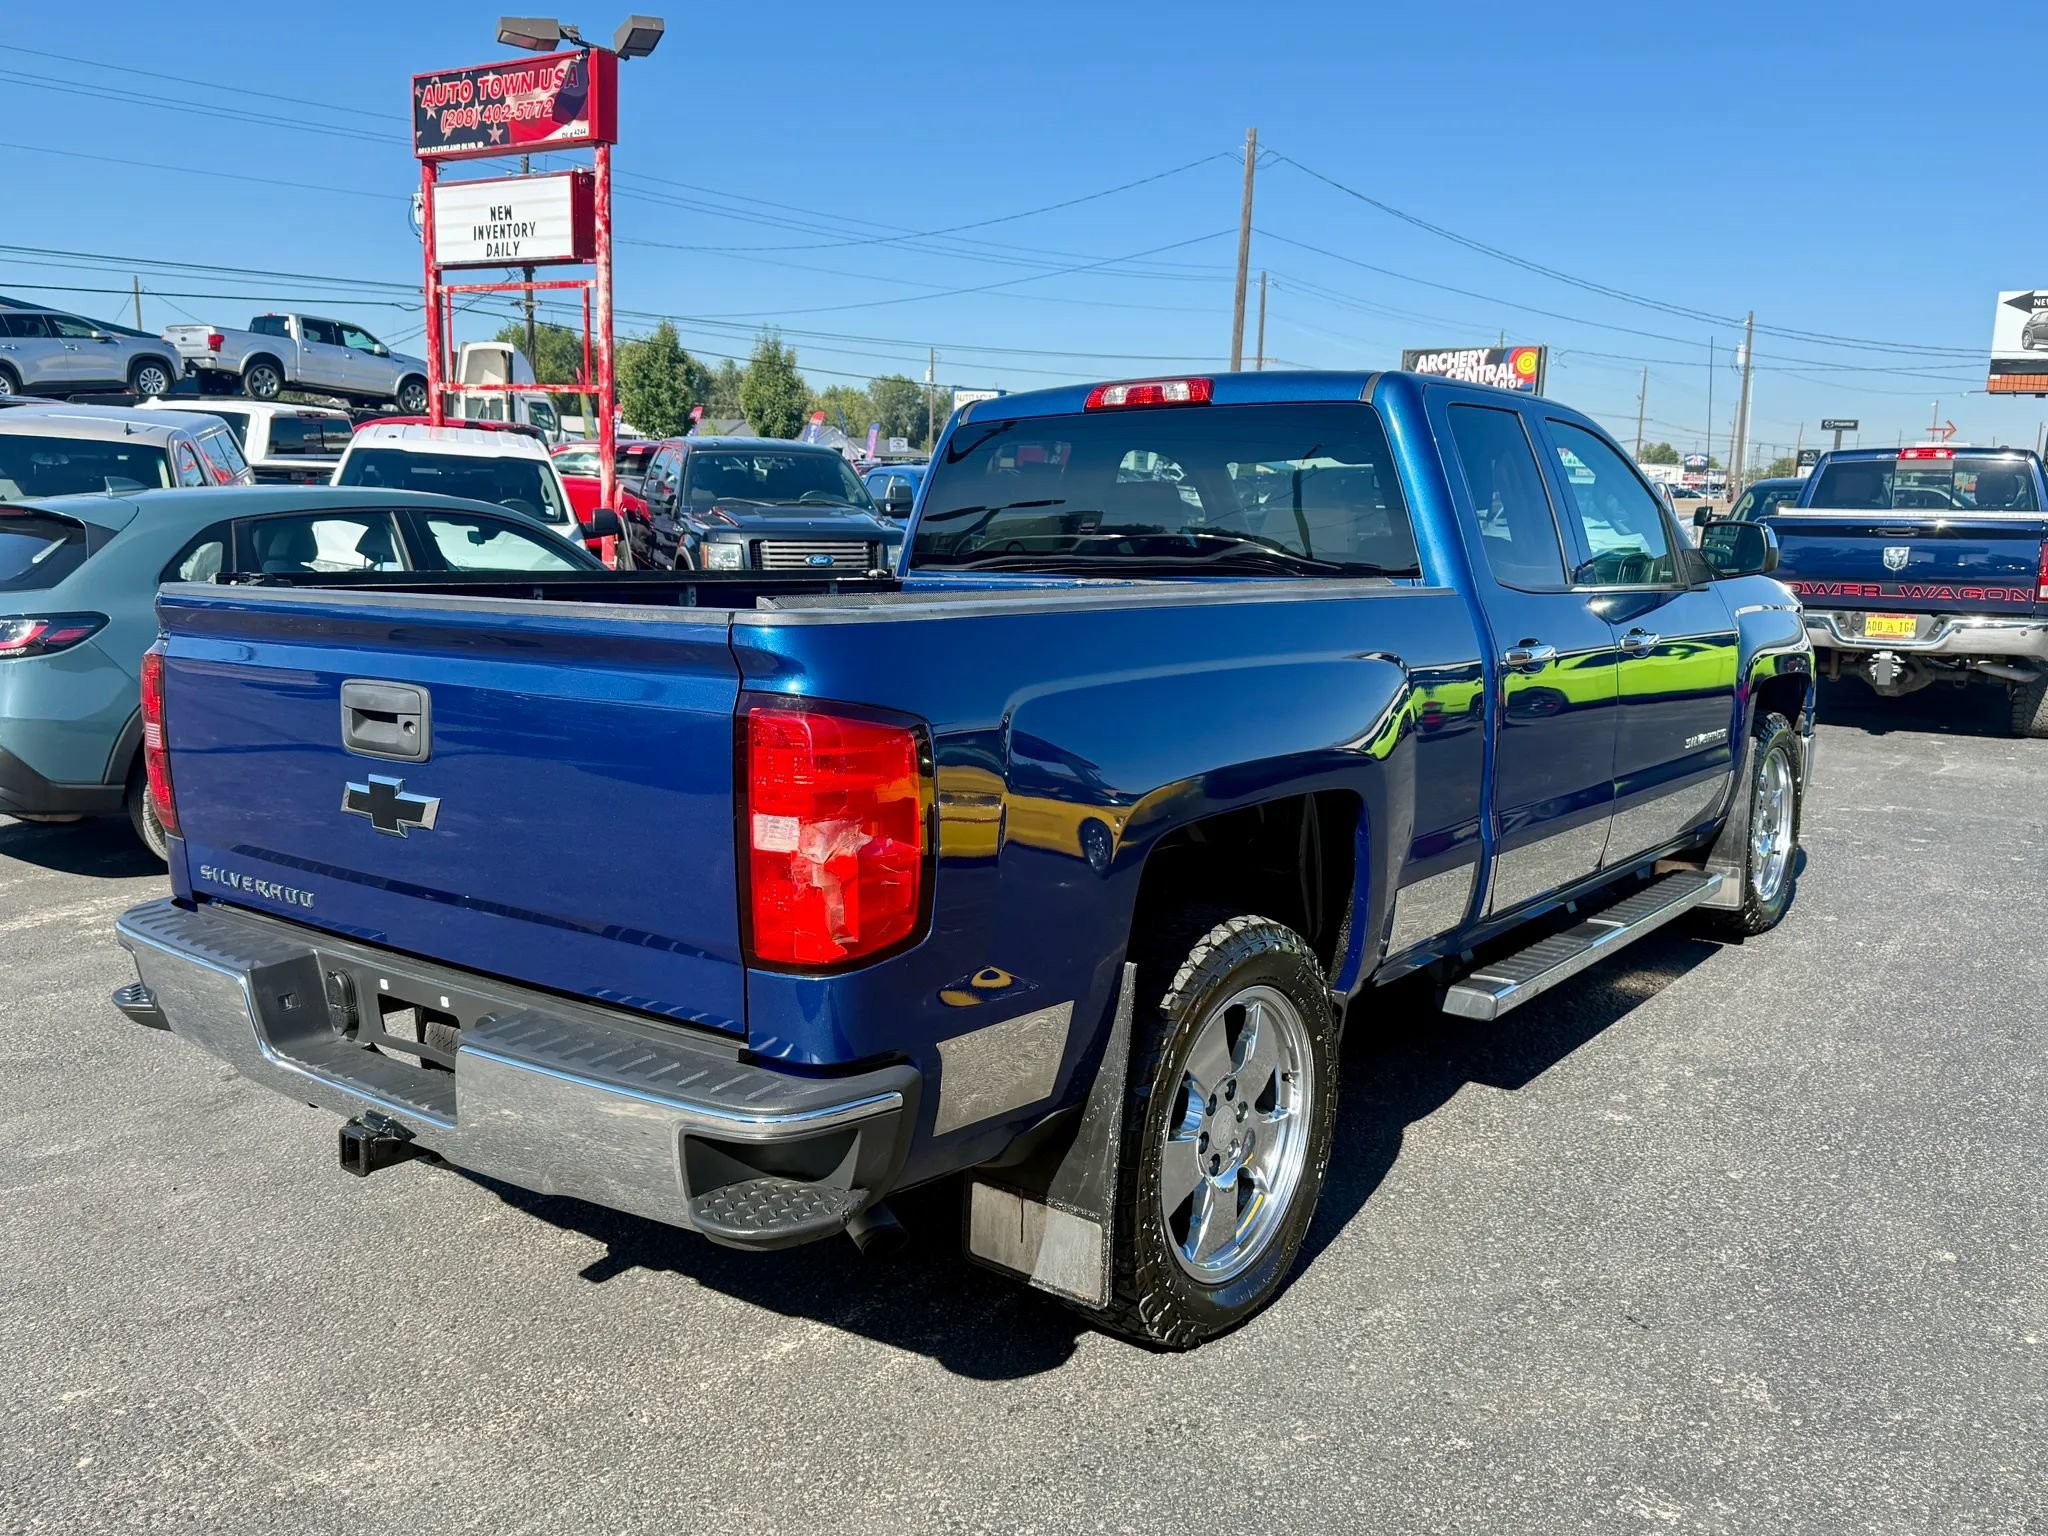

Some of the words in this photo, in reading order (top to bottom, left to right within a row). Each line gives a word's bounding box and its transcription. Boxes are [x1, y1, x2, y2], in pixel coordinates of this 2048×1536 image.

[421, 79, 473, 109] AUTO
[478, 71, 535, 100] TOWN
[539, 65, 578, 97] USA
[441, 107, 479, 133] (208)
[482, 97, 555, 124] 402-5772
[490, 205, 512, 222] NEW
[473, 221, 536, 241] INVENTORY
[486, 241, 520, 257] DAILY
[1415, 349, 1490, 374] ARCHERY
[1445, 363, 1517, 384] CENTRAL
[1900, 584, 2035, 602] WAGON
[200, 865, 315, 909] SILVERADO
